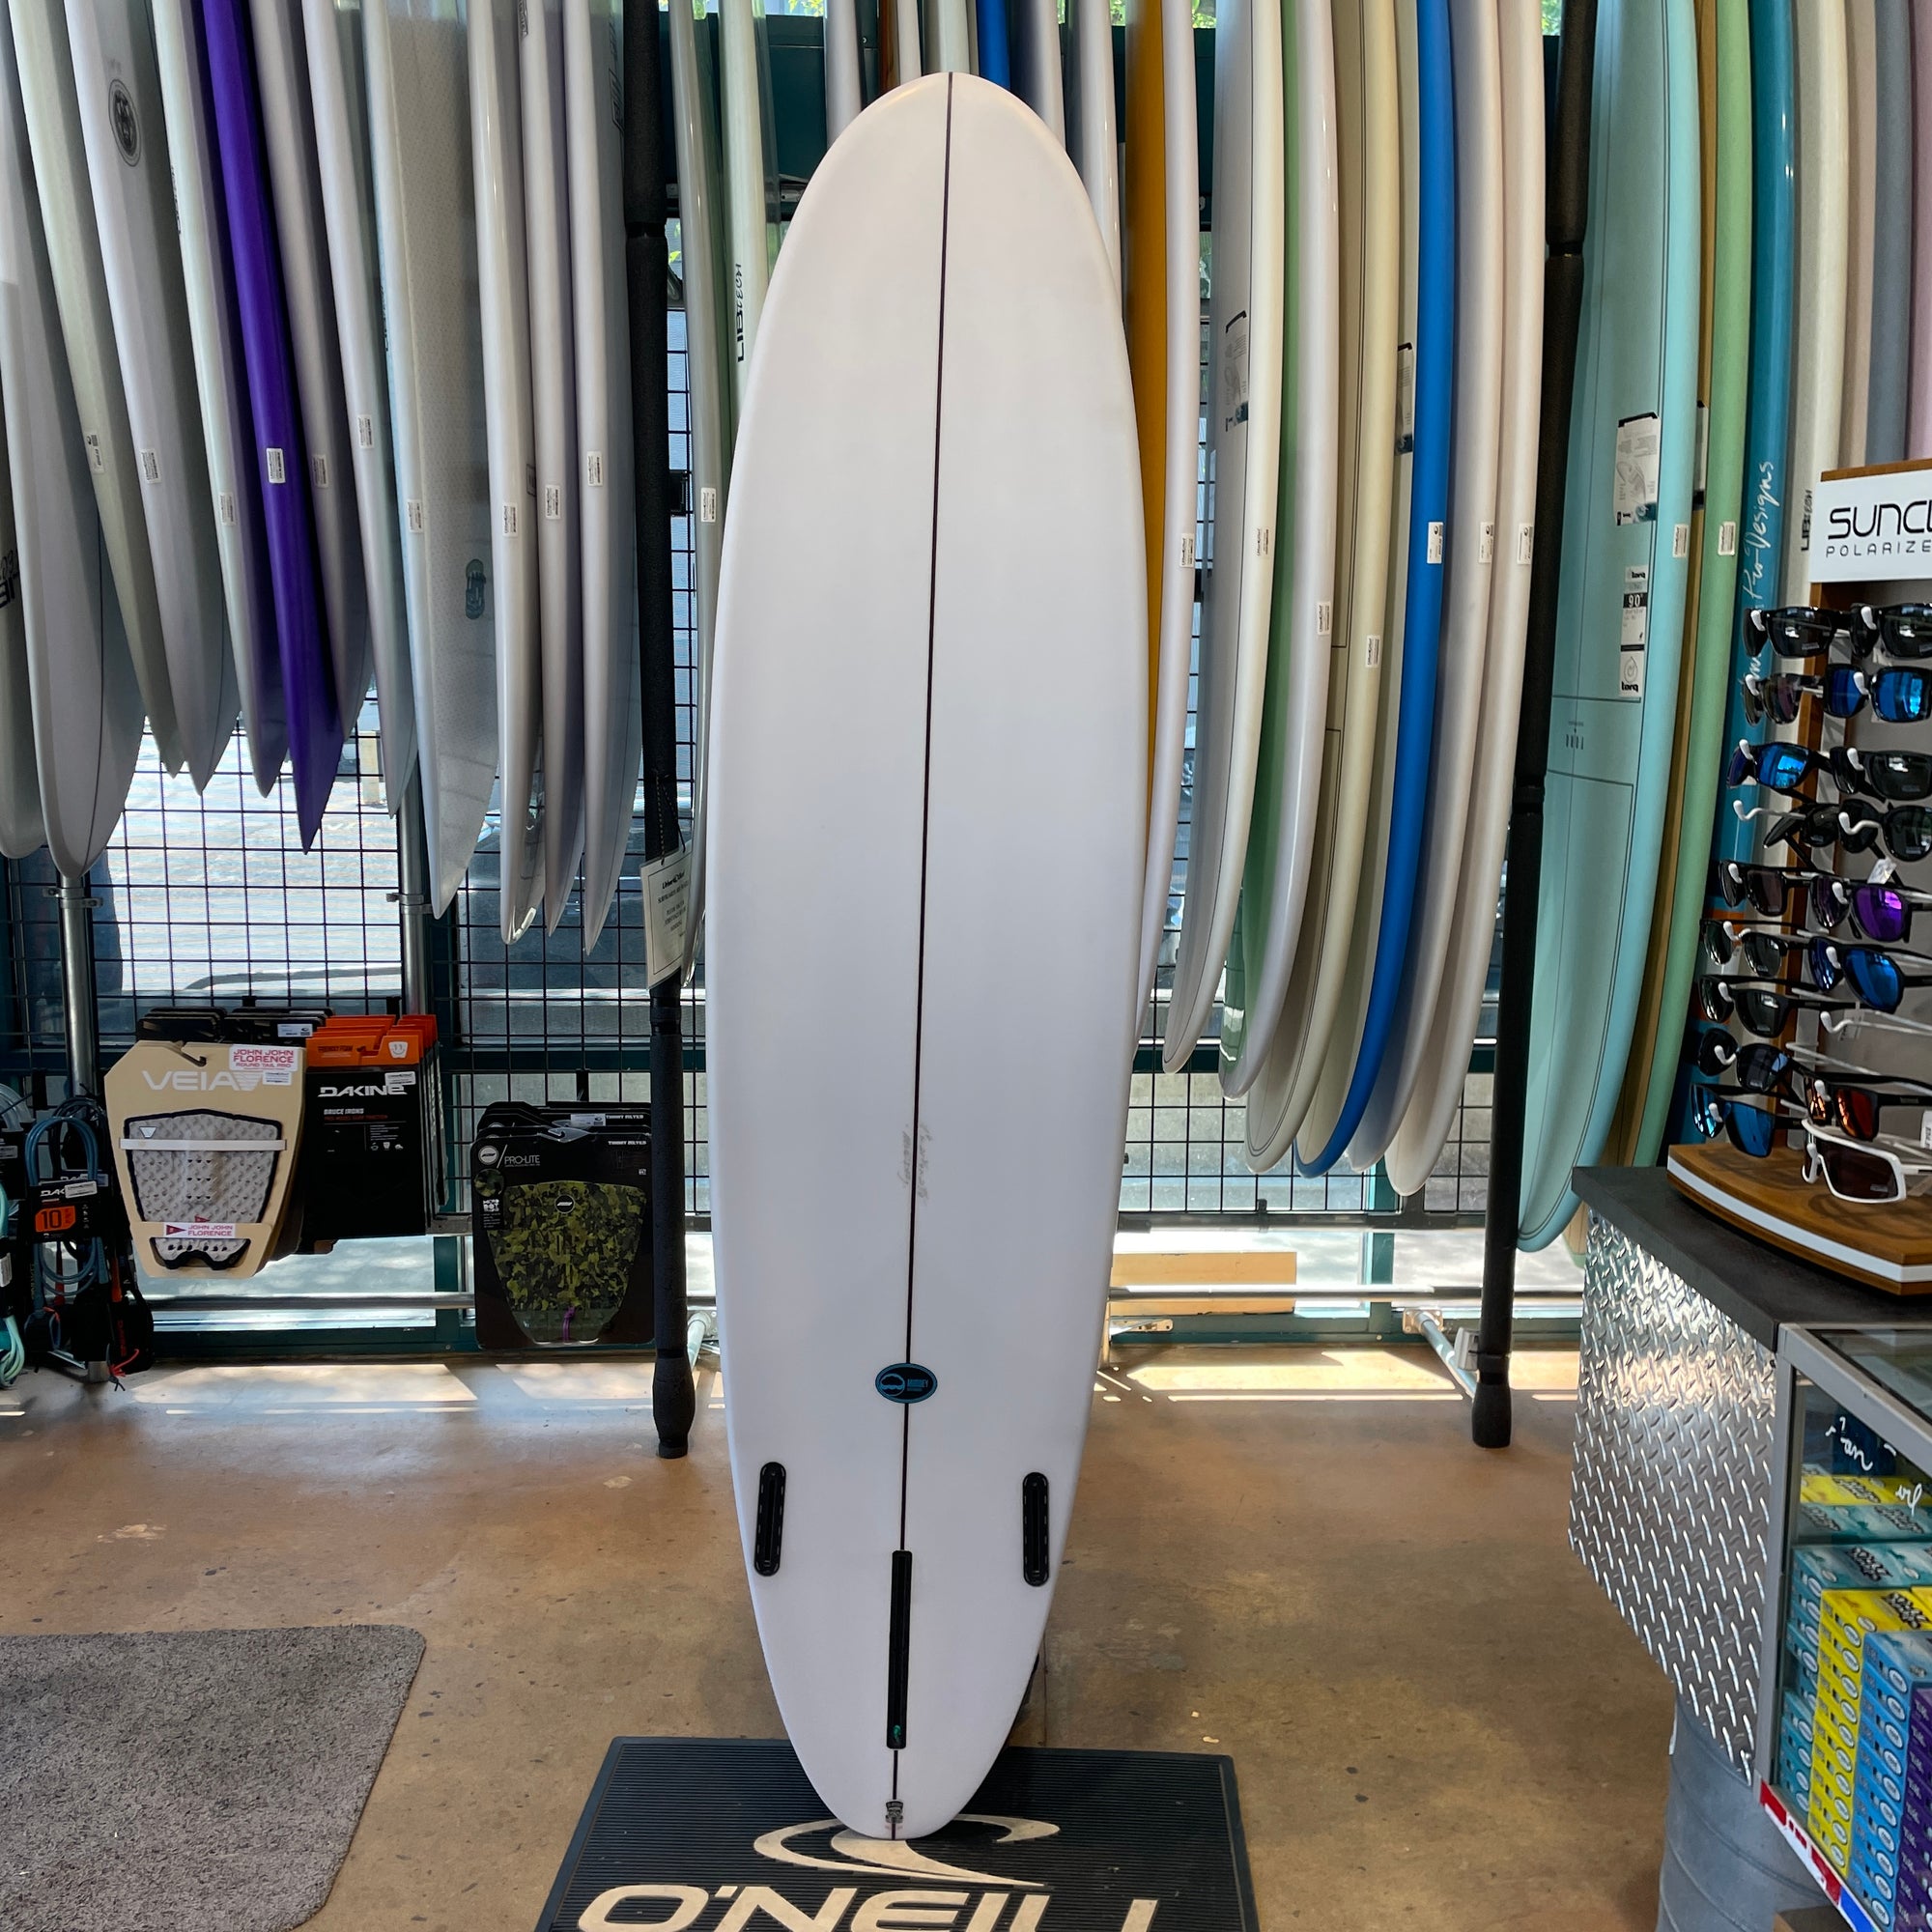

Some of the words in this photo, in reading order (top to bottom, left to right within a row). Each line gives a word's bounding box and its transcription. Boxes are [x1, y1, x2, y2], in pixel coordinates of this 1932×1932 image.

[1826, 539, 1932, 558] POLARIZE
[1621, 680, 1638, 693] torq
[141, 1070, 242, 1092] VEIA
[42, 1209, 62, 1230] 10
